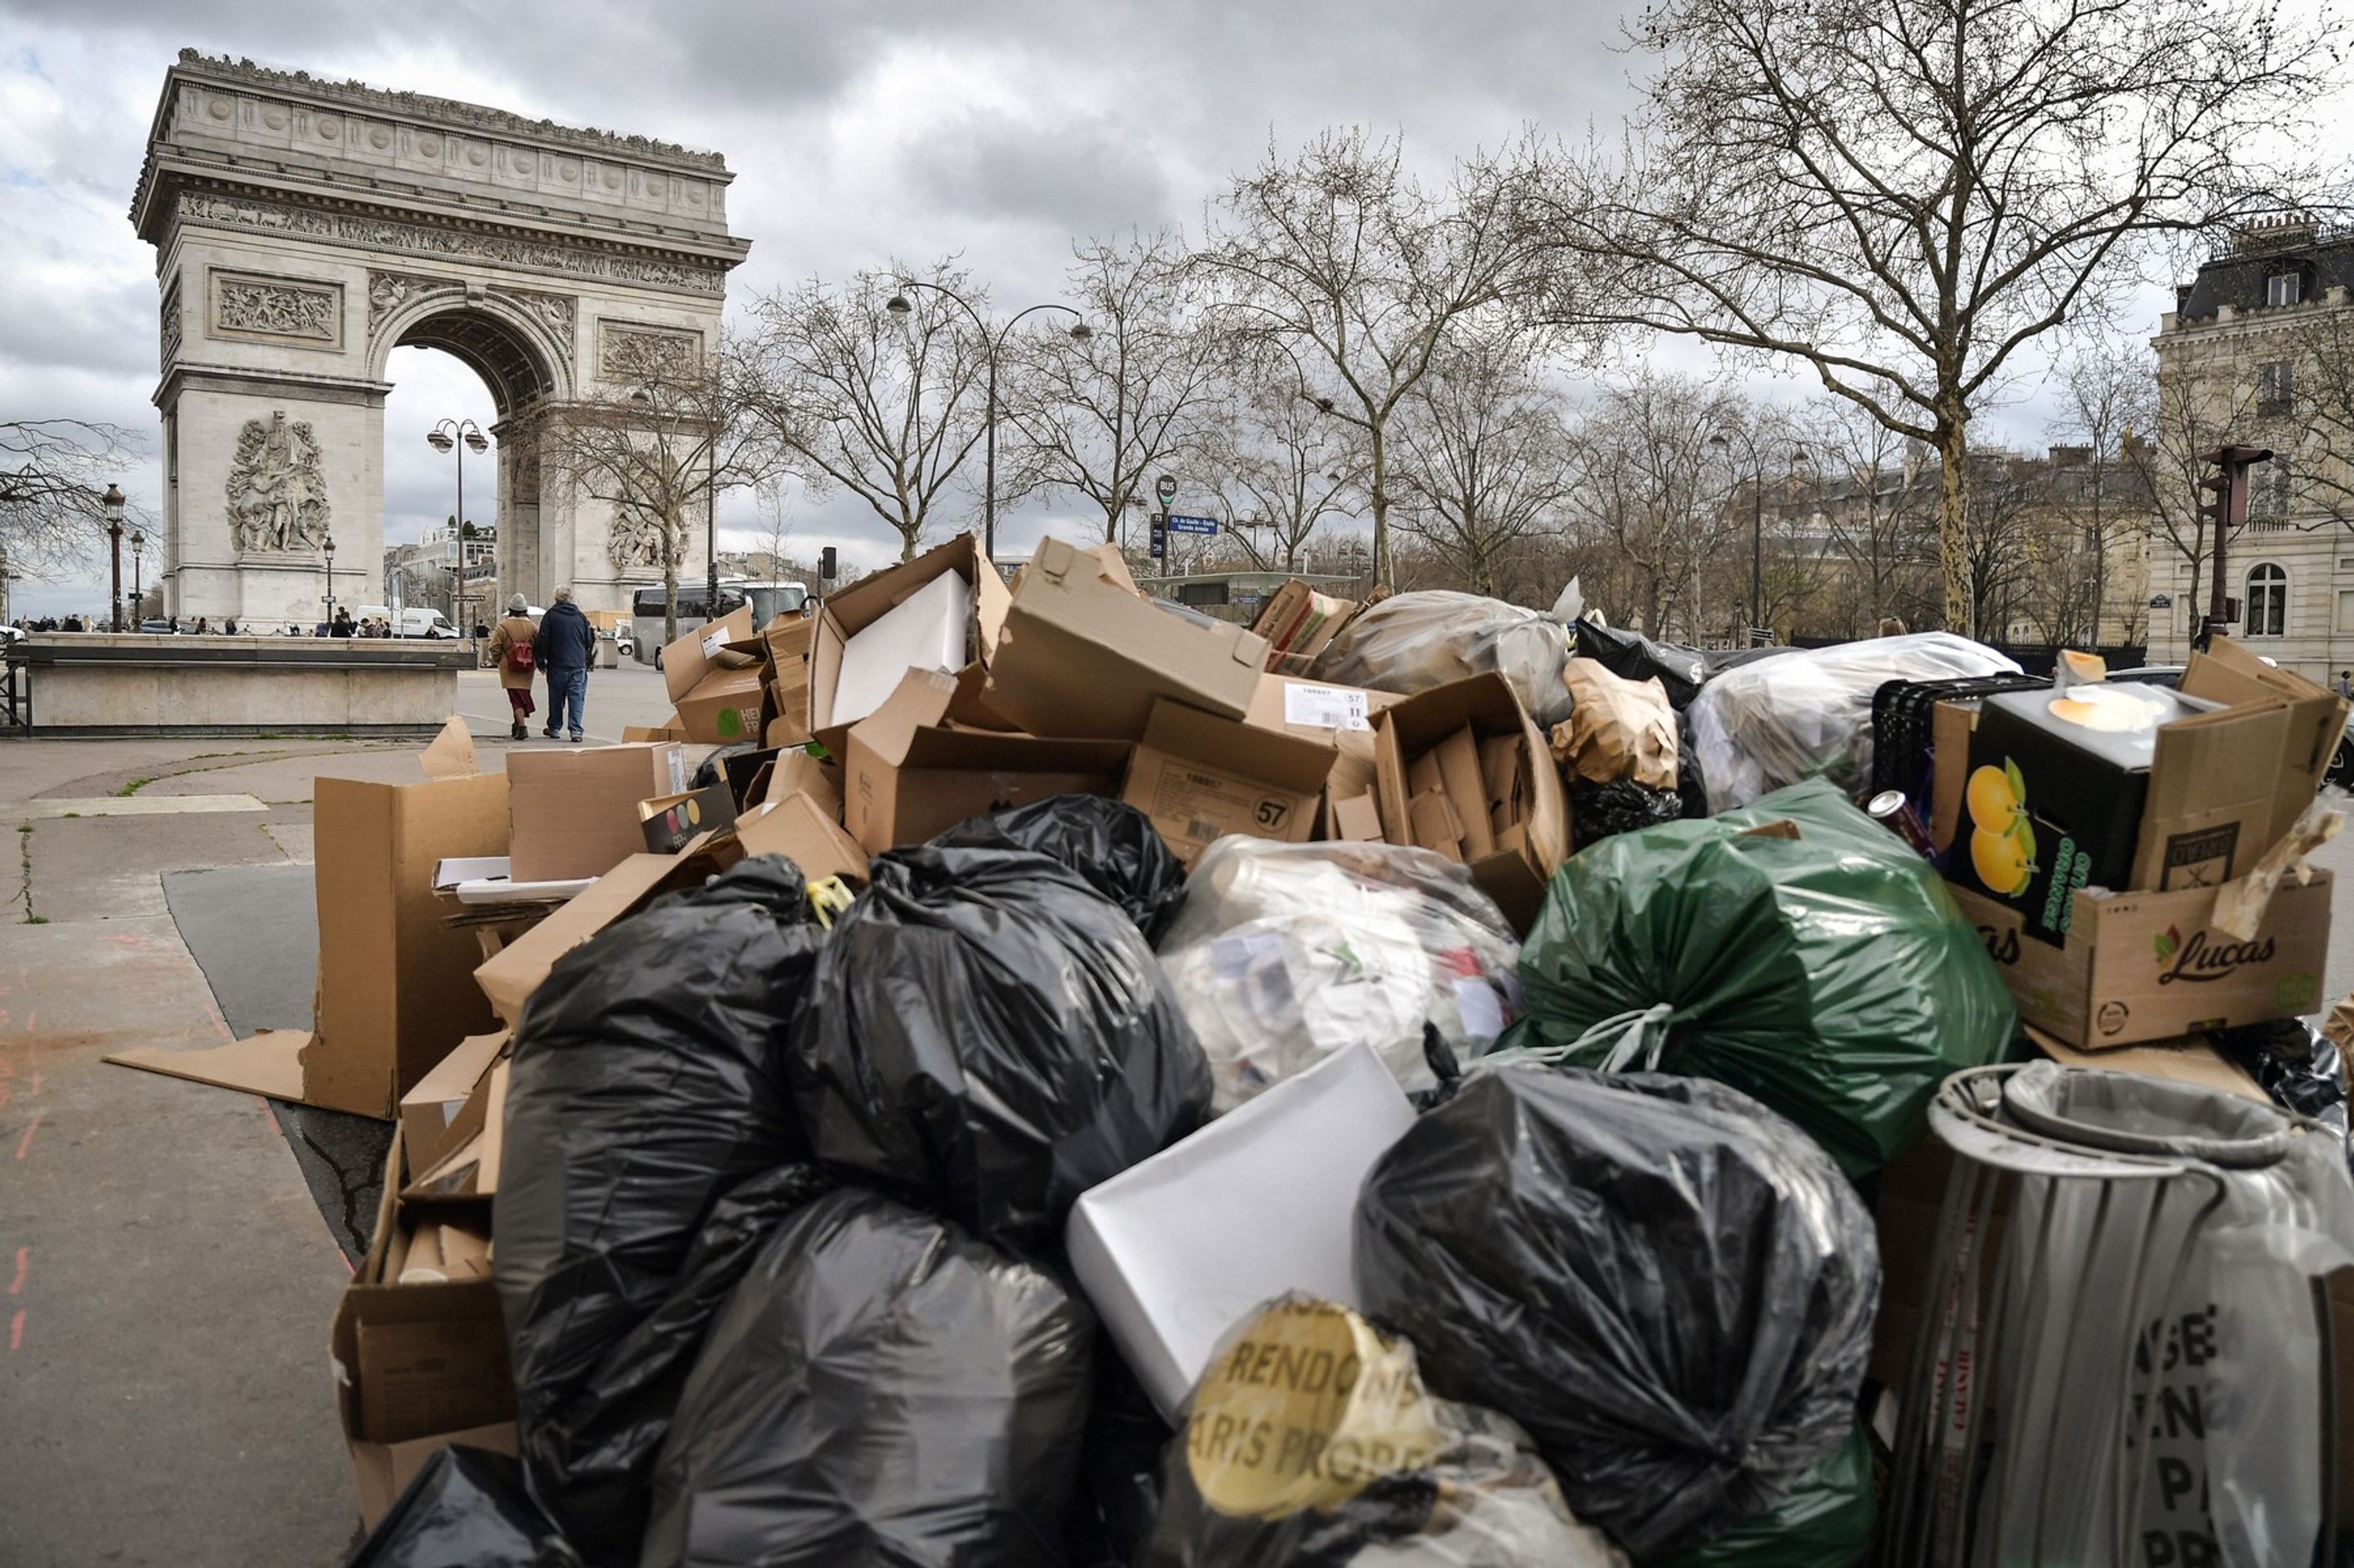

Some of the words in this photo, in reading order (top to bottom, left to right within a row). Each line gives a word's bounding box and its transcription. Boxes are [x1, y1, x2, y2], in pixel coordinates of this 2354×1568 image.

[1160, 481, 1175, 491] BUS
[1348, 694, 1360, 702] 57
[1256, 800, 1286, 826] 57
[2042, 838, 2074, 931] ORANGE
[2158, 930, 2276, 985] Lucas
[1189, 1410, 1271, 1468] ARIS
